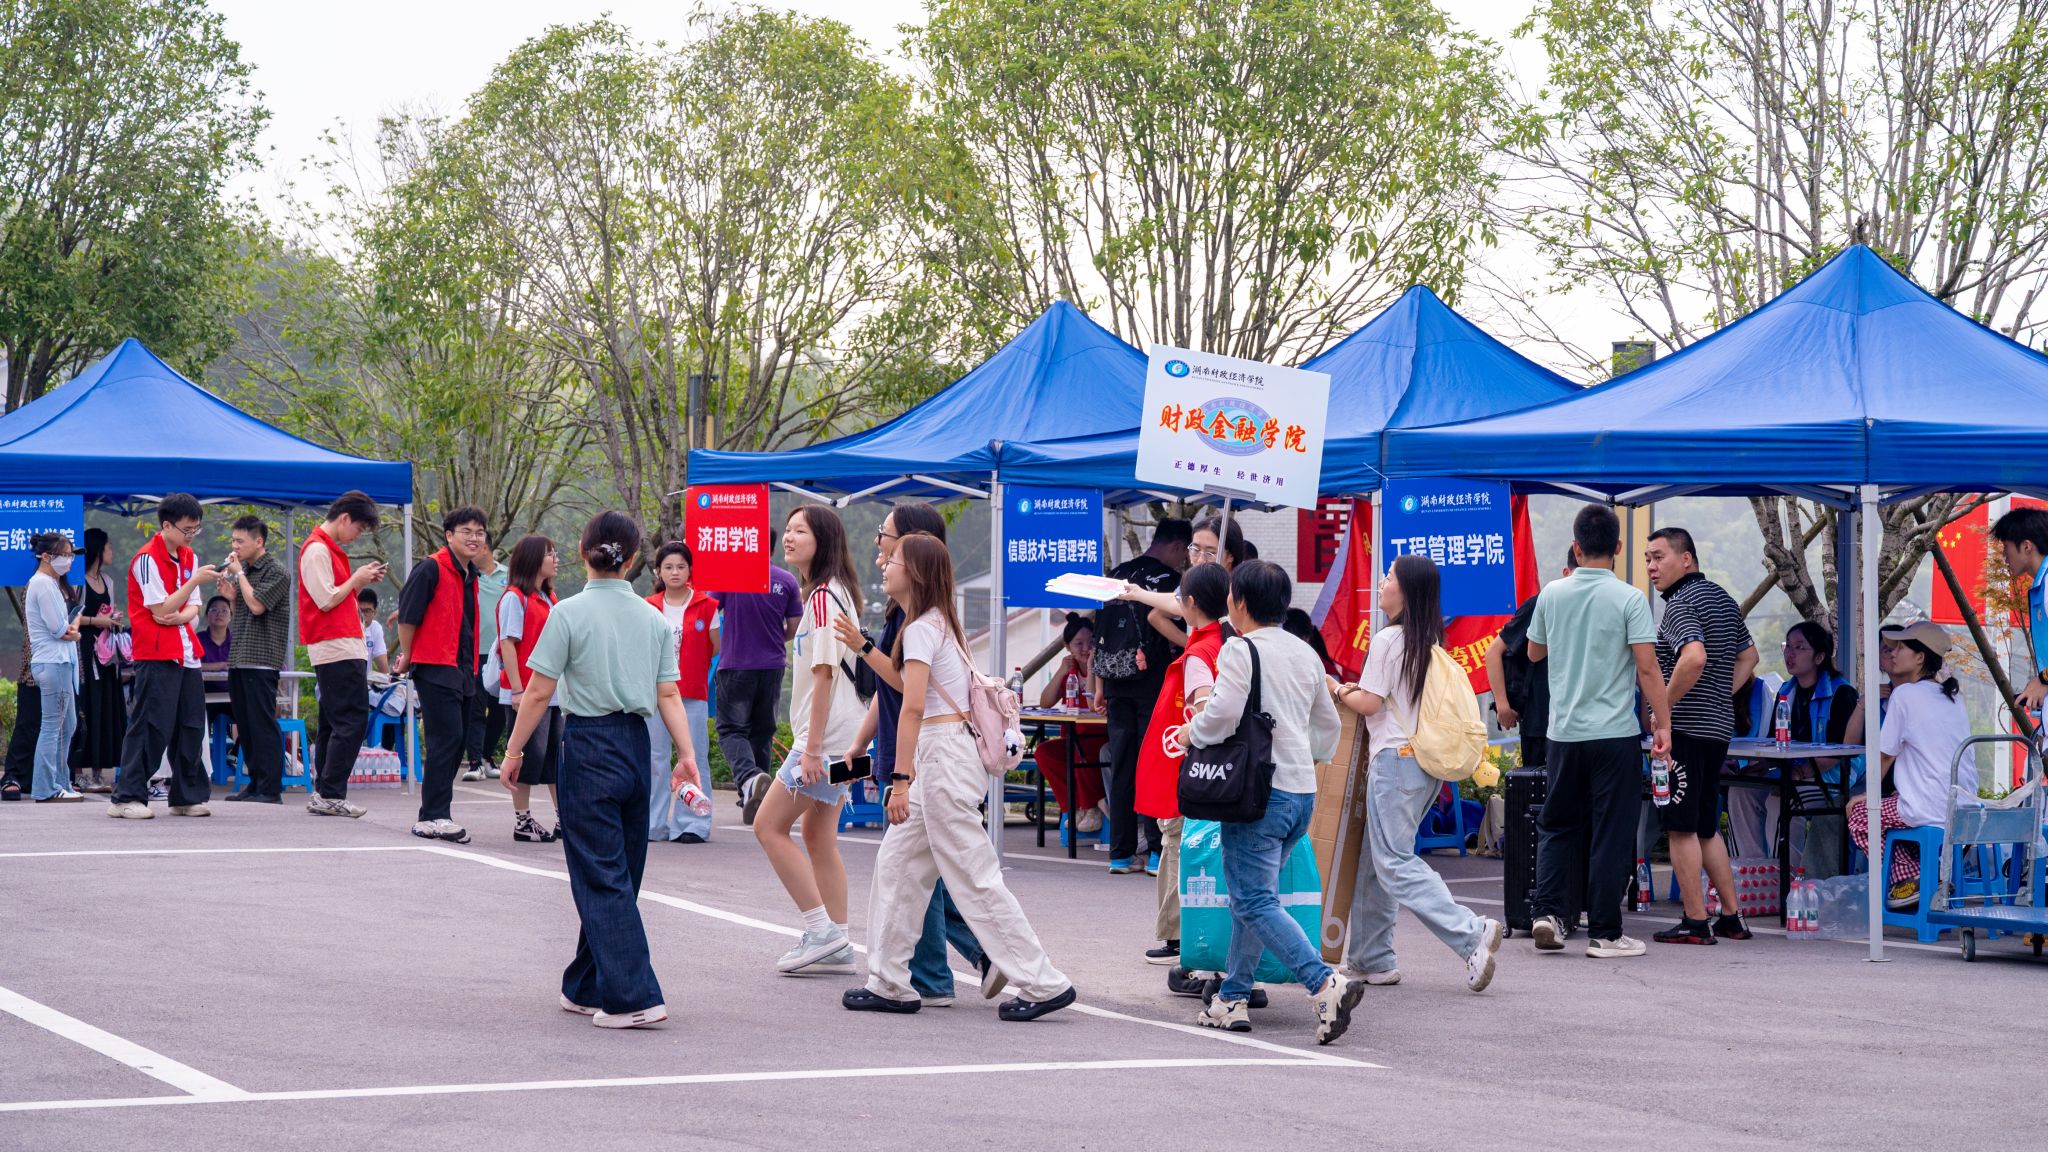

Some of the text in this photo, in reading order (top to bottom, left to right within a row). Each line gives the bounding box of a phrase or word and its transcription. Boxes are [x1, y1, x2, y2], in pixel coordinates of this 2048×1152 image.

[1192, 364, 1264, 387] 湖南财政经济学院
[1159, 403, 1307, 453] 财政金融学院
[1174, 459, 1284, 487] 正德厚生 经世济用
[1034, 498, 1088, 510] 湖南财政经济学院
[1421, 491, 1491, 508] 湖南财政经济学院
[698, 526, 759, 553] 济用学馆
[1008, 539, 1097, 563] 信息技术与管理学院
